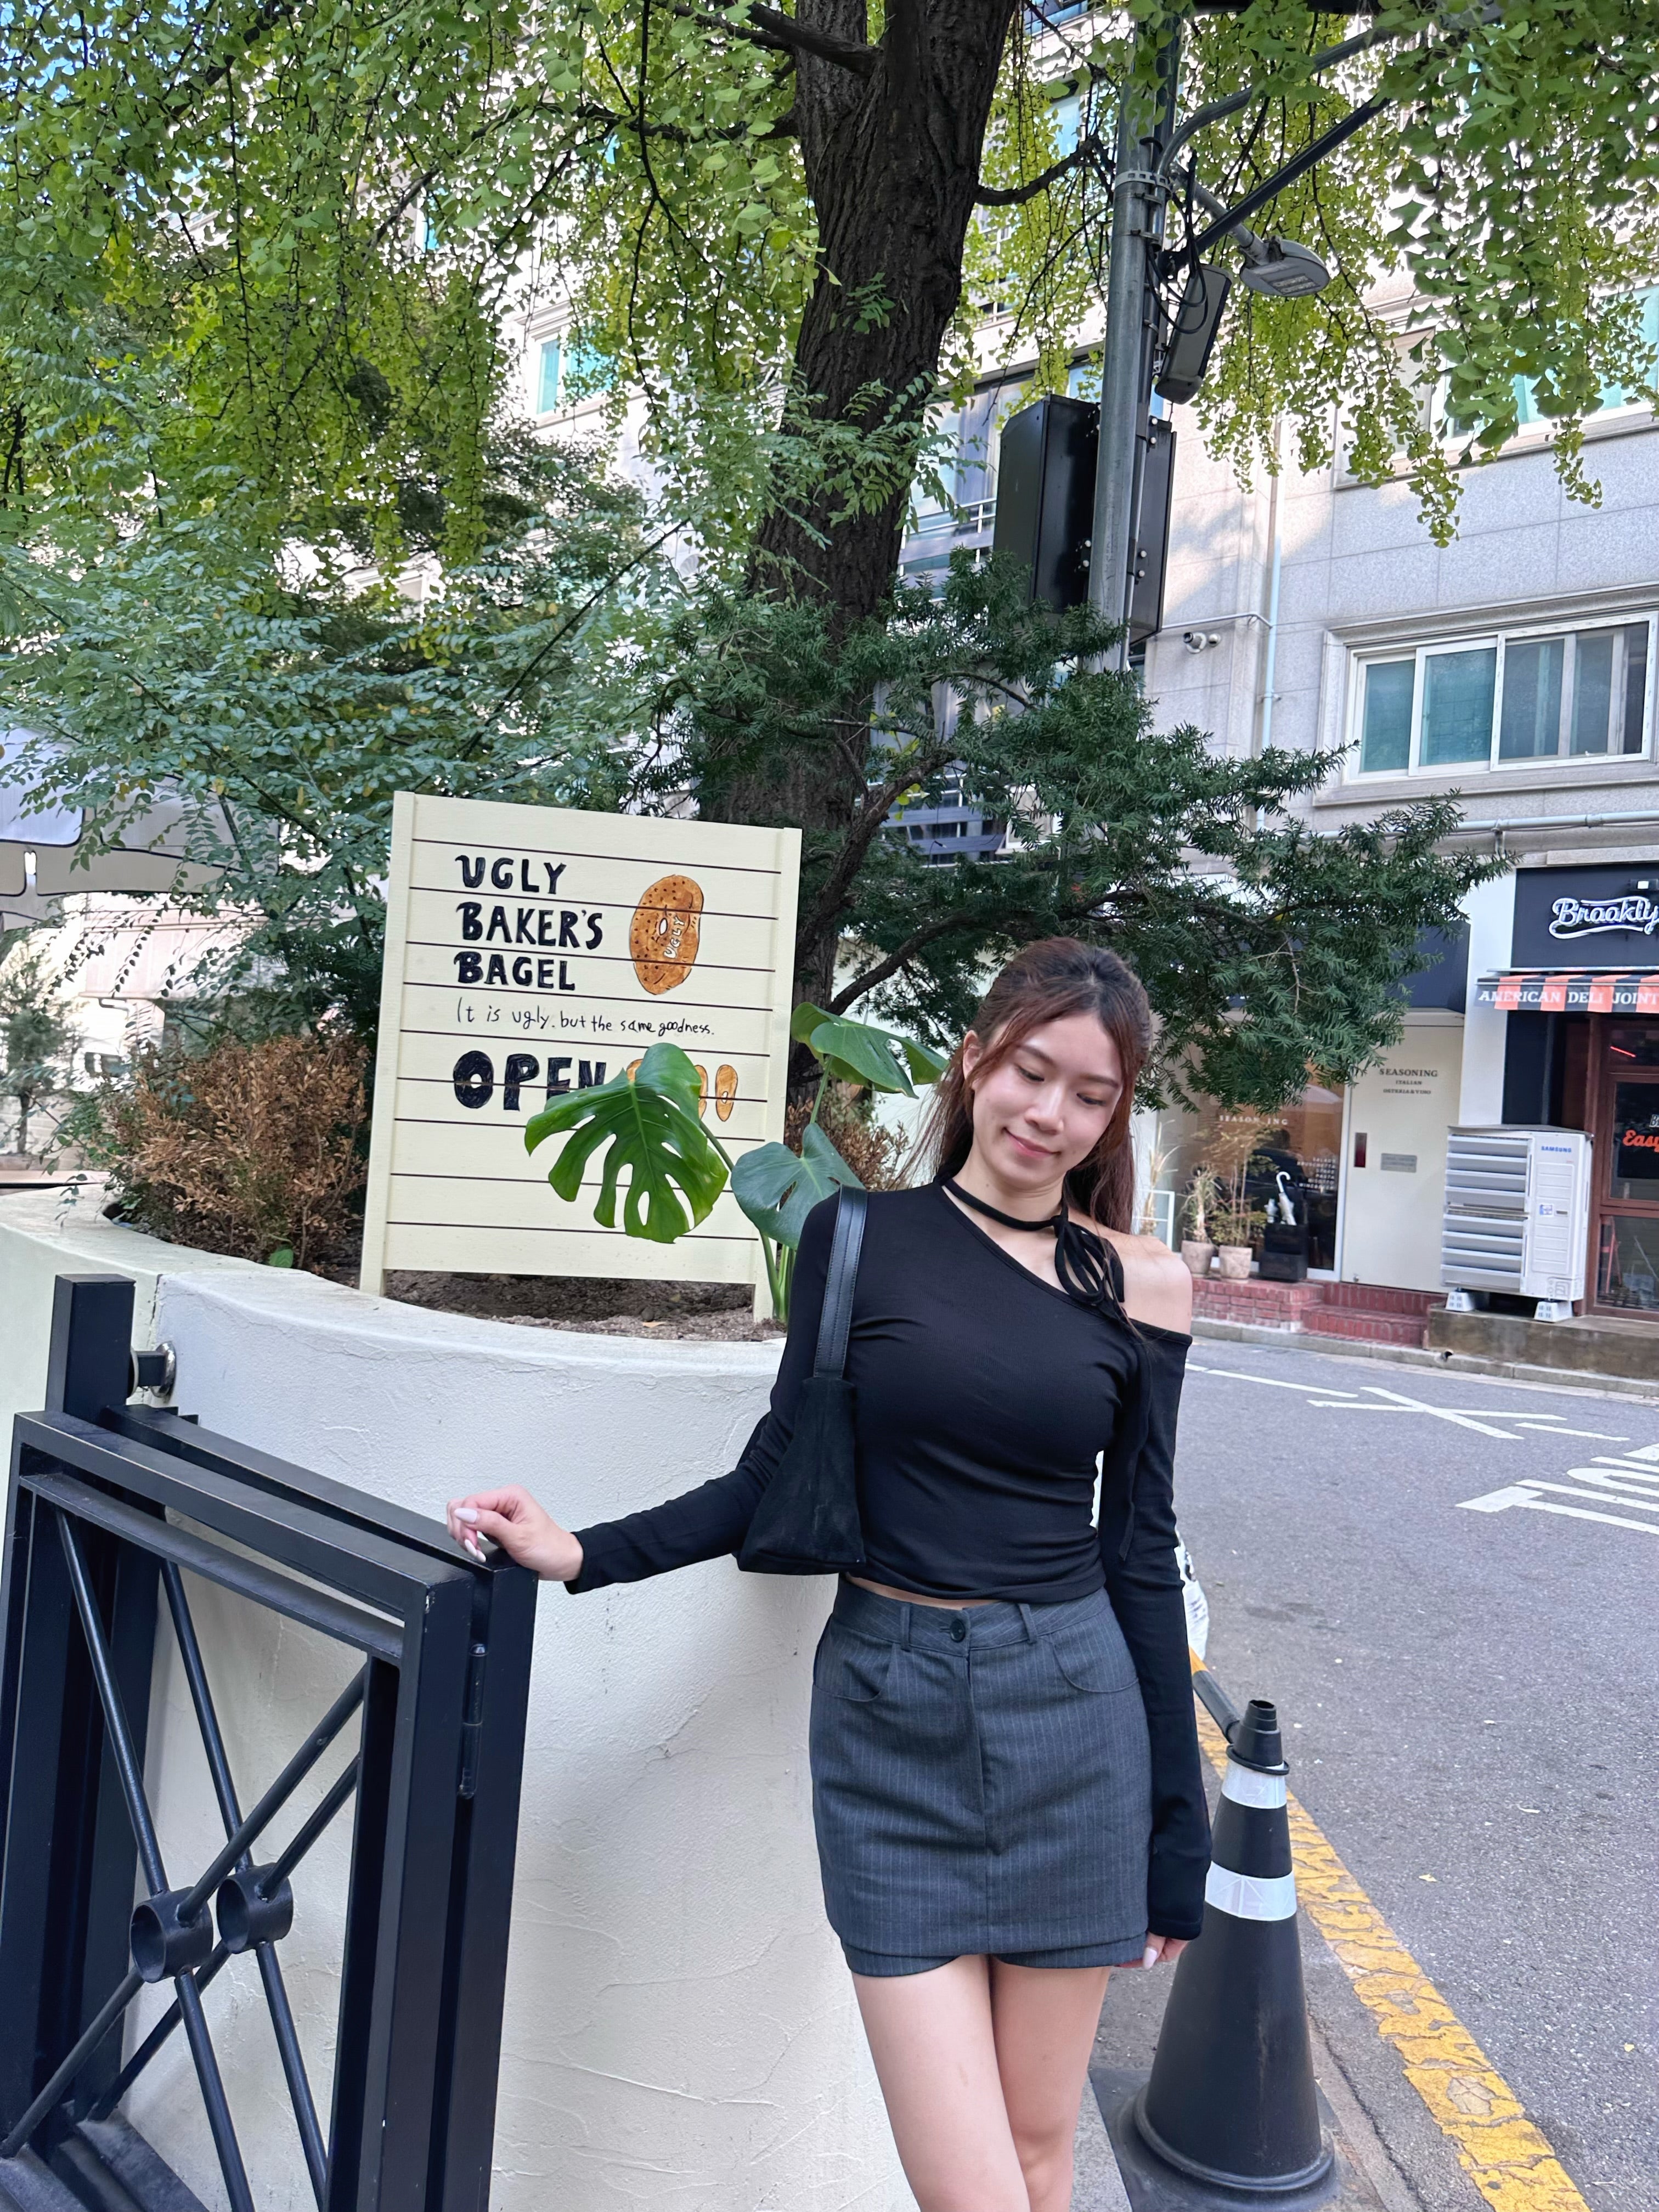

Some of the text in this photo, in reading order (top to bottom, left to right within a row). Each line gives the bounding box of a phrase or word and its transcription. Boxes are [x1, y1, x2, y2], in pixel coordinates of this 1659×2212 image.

[455, 855, 567, 895] UGLY
[456, 901, 603, 950] BAKER'S
[663, 915, 685, 958] UGLY
[454, 951, 575, 991] BAGEL
[457, 997, 475, 1023] It
[487, 1005, 501, 1022] is
[561, 1010, 586, 1028] but
[591, 1015, 612, 1032] the
[621, 1020, 656, 1033] same
[658, 1018, 714, 1036] goodness.
[1478, 990, 1658, 1005] AMERICAN DELI JOINT
[1379, 1068, 1438, 1077] SEASONING
